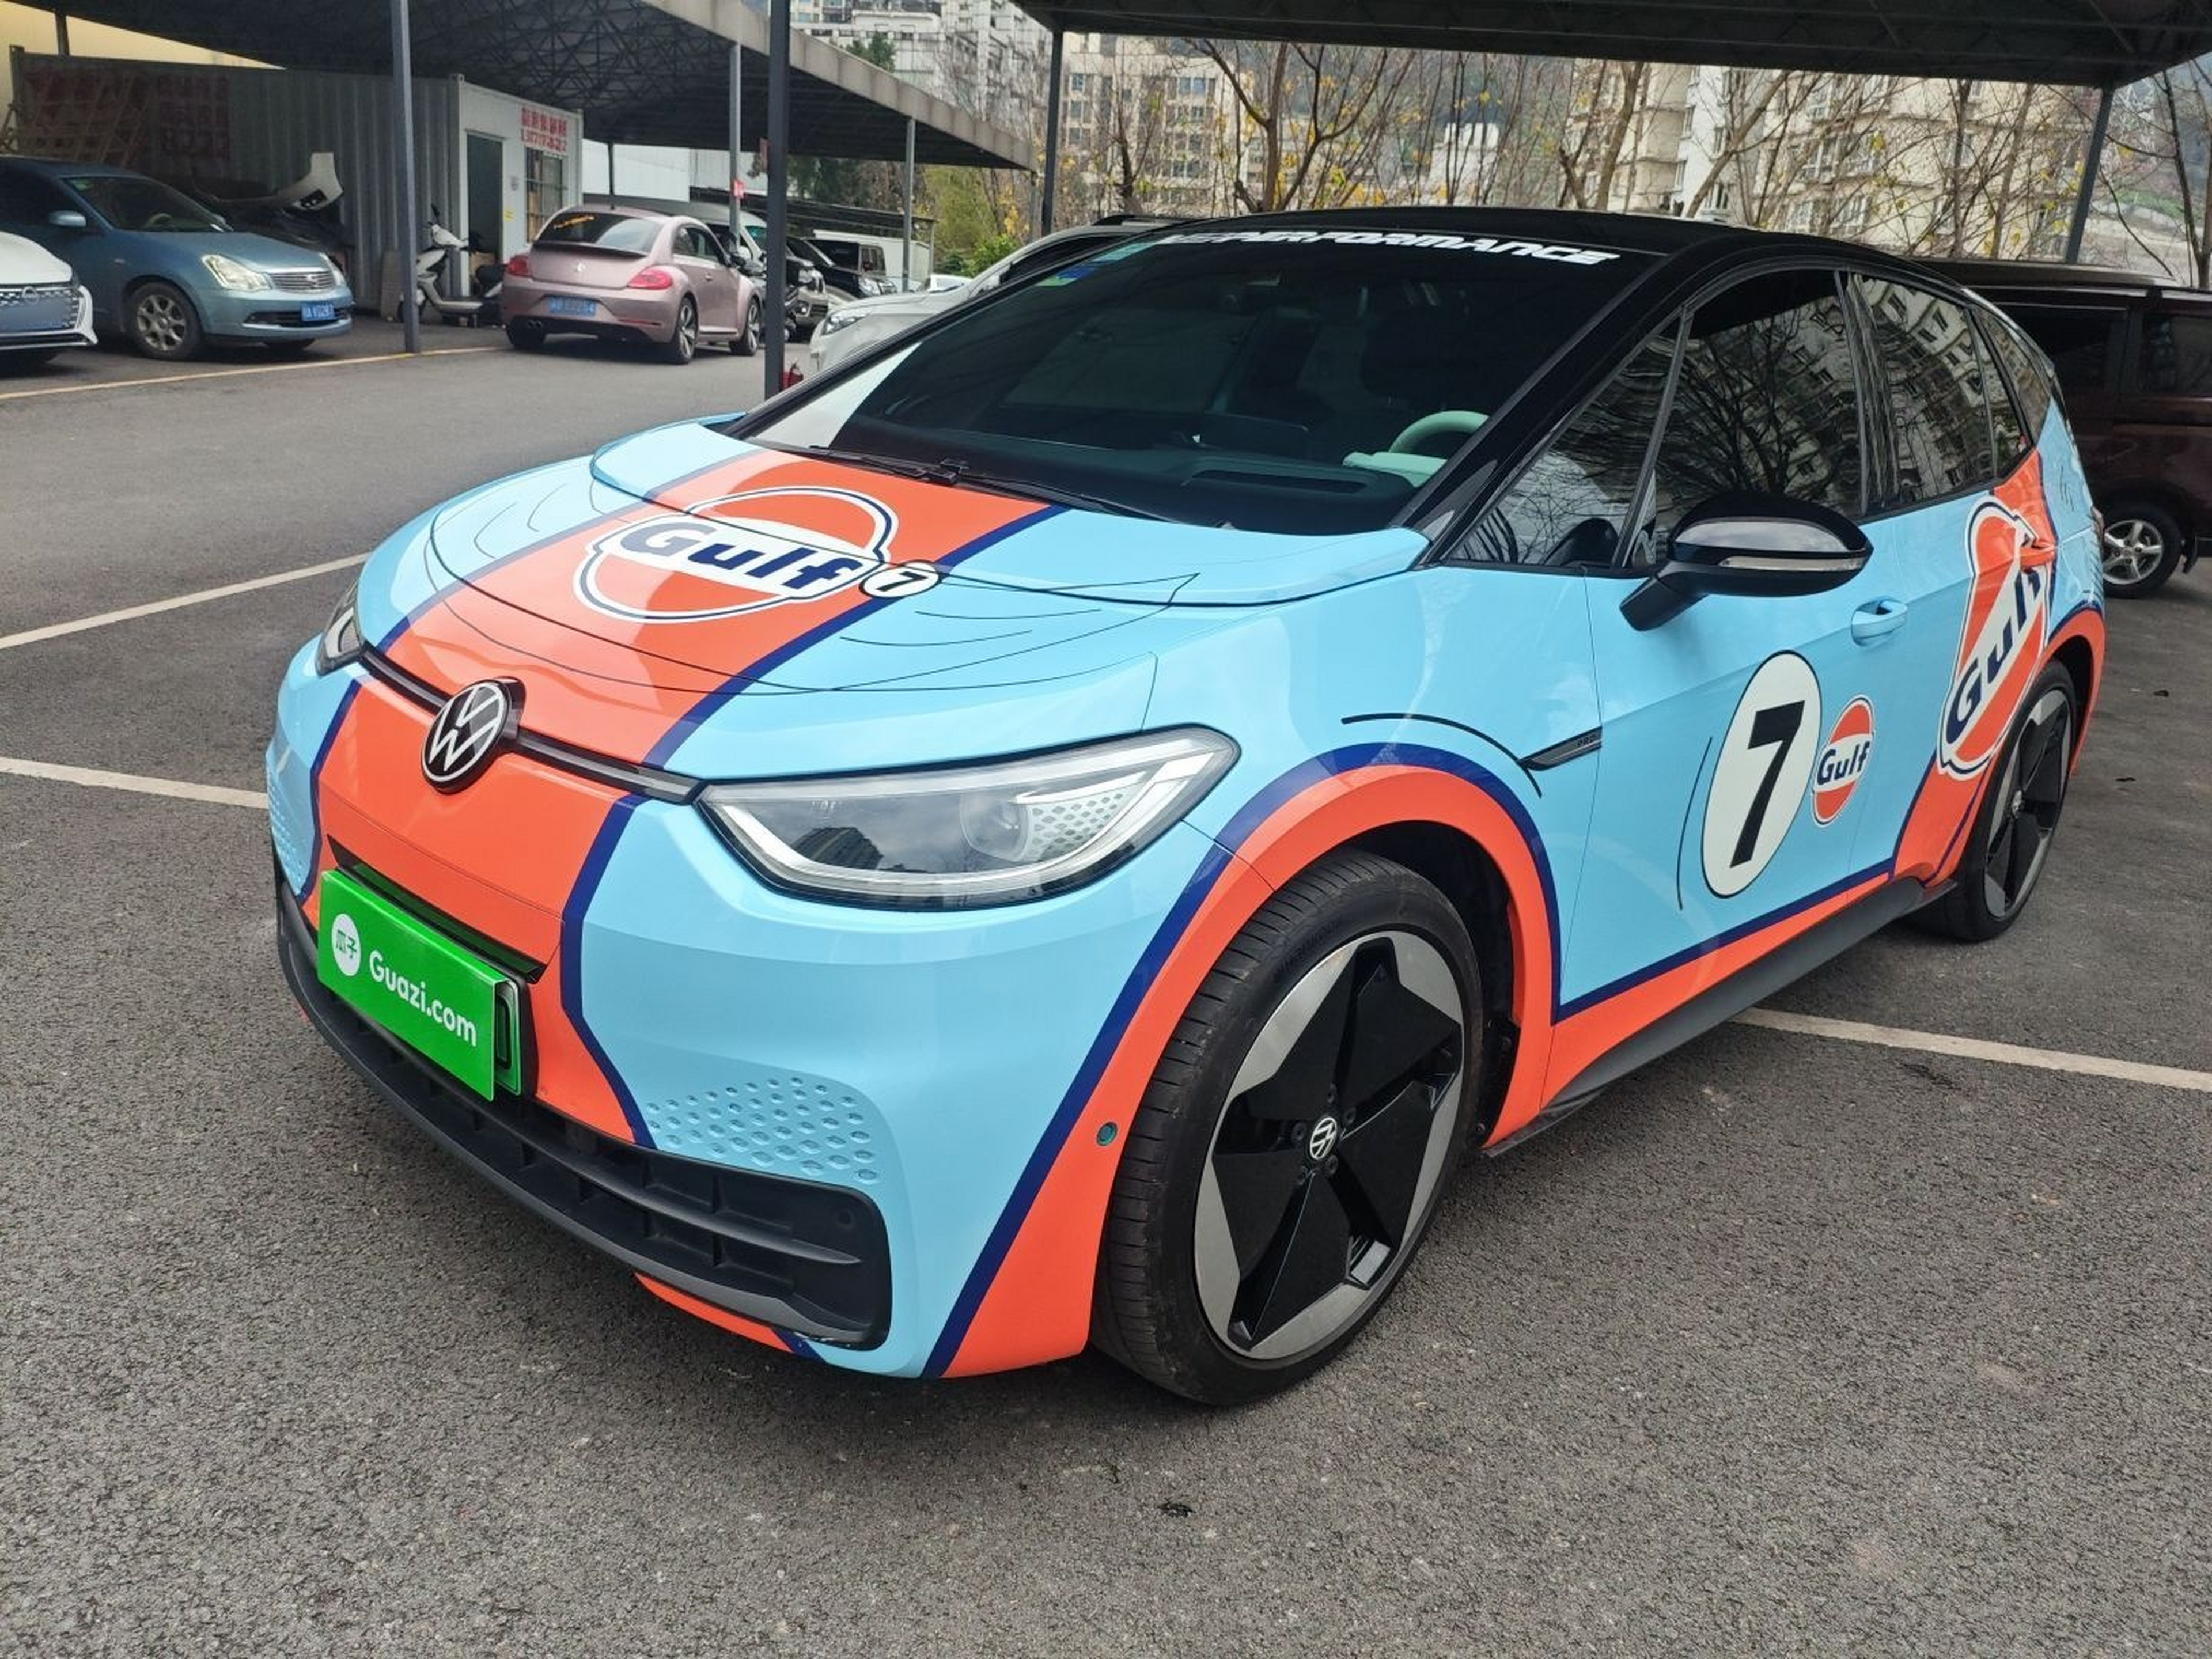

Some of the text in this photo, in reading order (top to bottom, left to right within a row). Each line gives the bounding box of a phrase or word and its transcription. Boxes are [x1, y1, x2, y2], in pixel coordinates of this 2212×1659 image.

[620, 521, 863, 590] Gulf
[877, 570, 929, 592] 7
[1729, 700, 1805, 869] 7
[1817, 740, 1870, 786] Gulf
[335, 929, 357, 959] 瓜子
[369, 950, 477, 1047] Guazi.com
